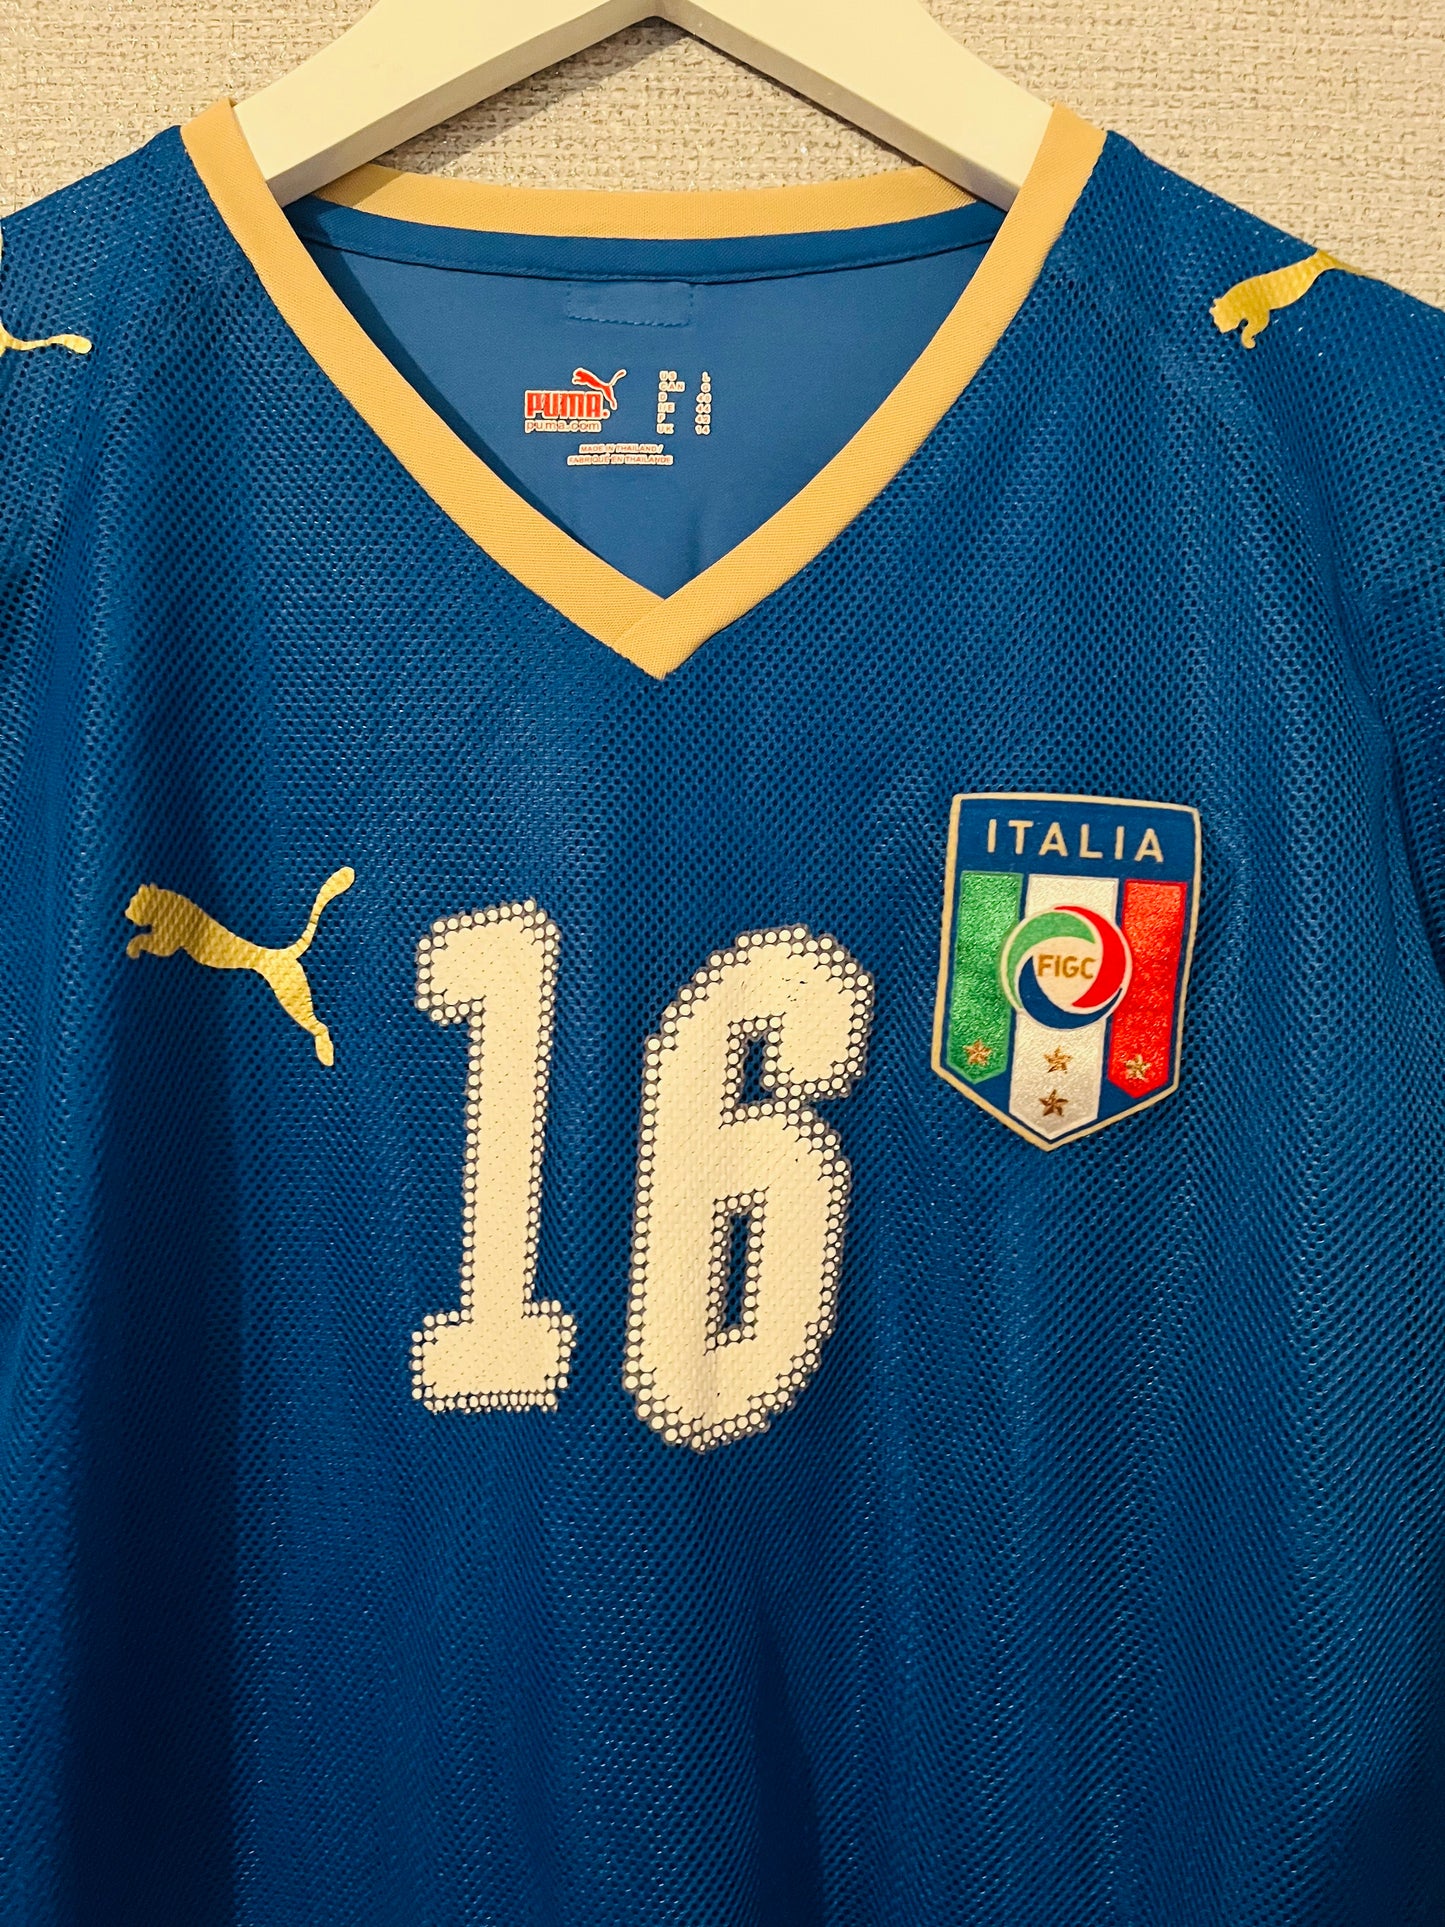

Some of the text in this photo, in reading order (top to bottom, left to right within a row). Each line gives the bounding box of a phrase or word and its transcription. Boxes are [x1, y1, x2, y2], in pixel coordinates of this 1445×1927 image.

[660, 371, 676, 381] US
[660, 382, 684, 391] CAN
[659, 392, 667, 401] D
[526, 421, 600, 432] puma.com
[658, 425, 673, 433] UK
[580, 445, 604, 453] MADE
[987, 819, 1164, 863] ITALIA
[1036, 953, 1097, 980] FIGC
[411, 900, 873, 1453] 16
